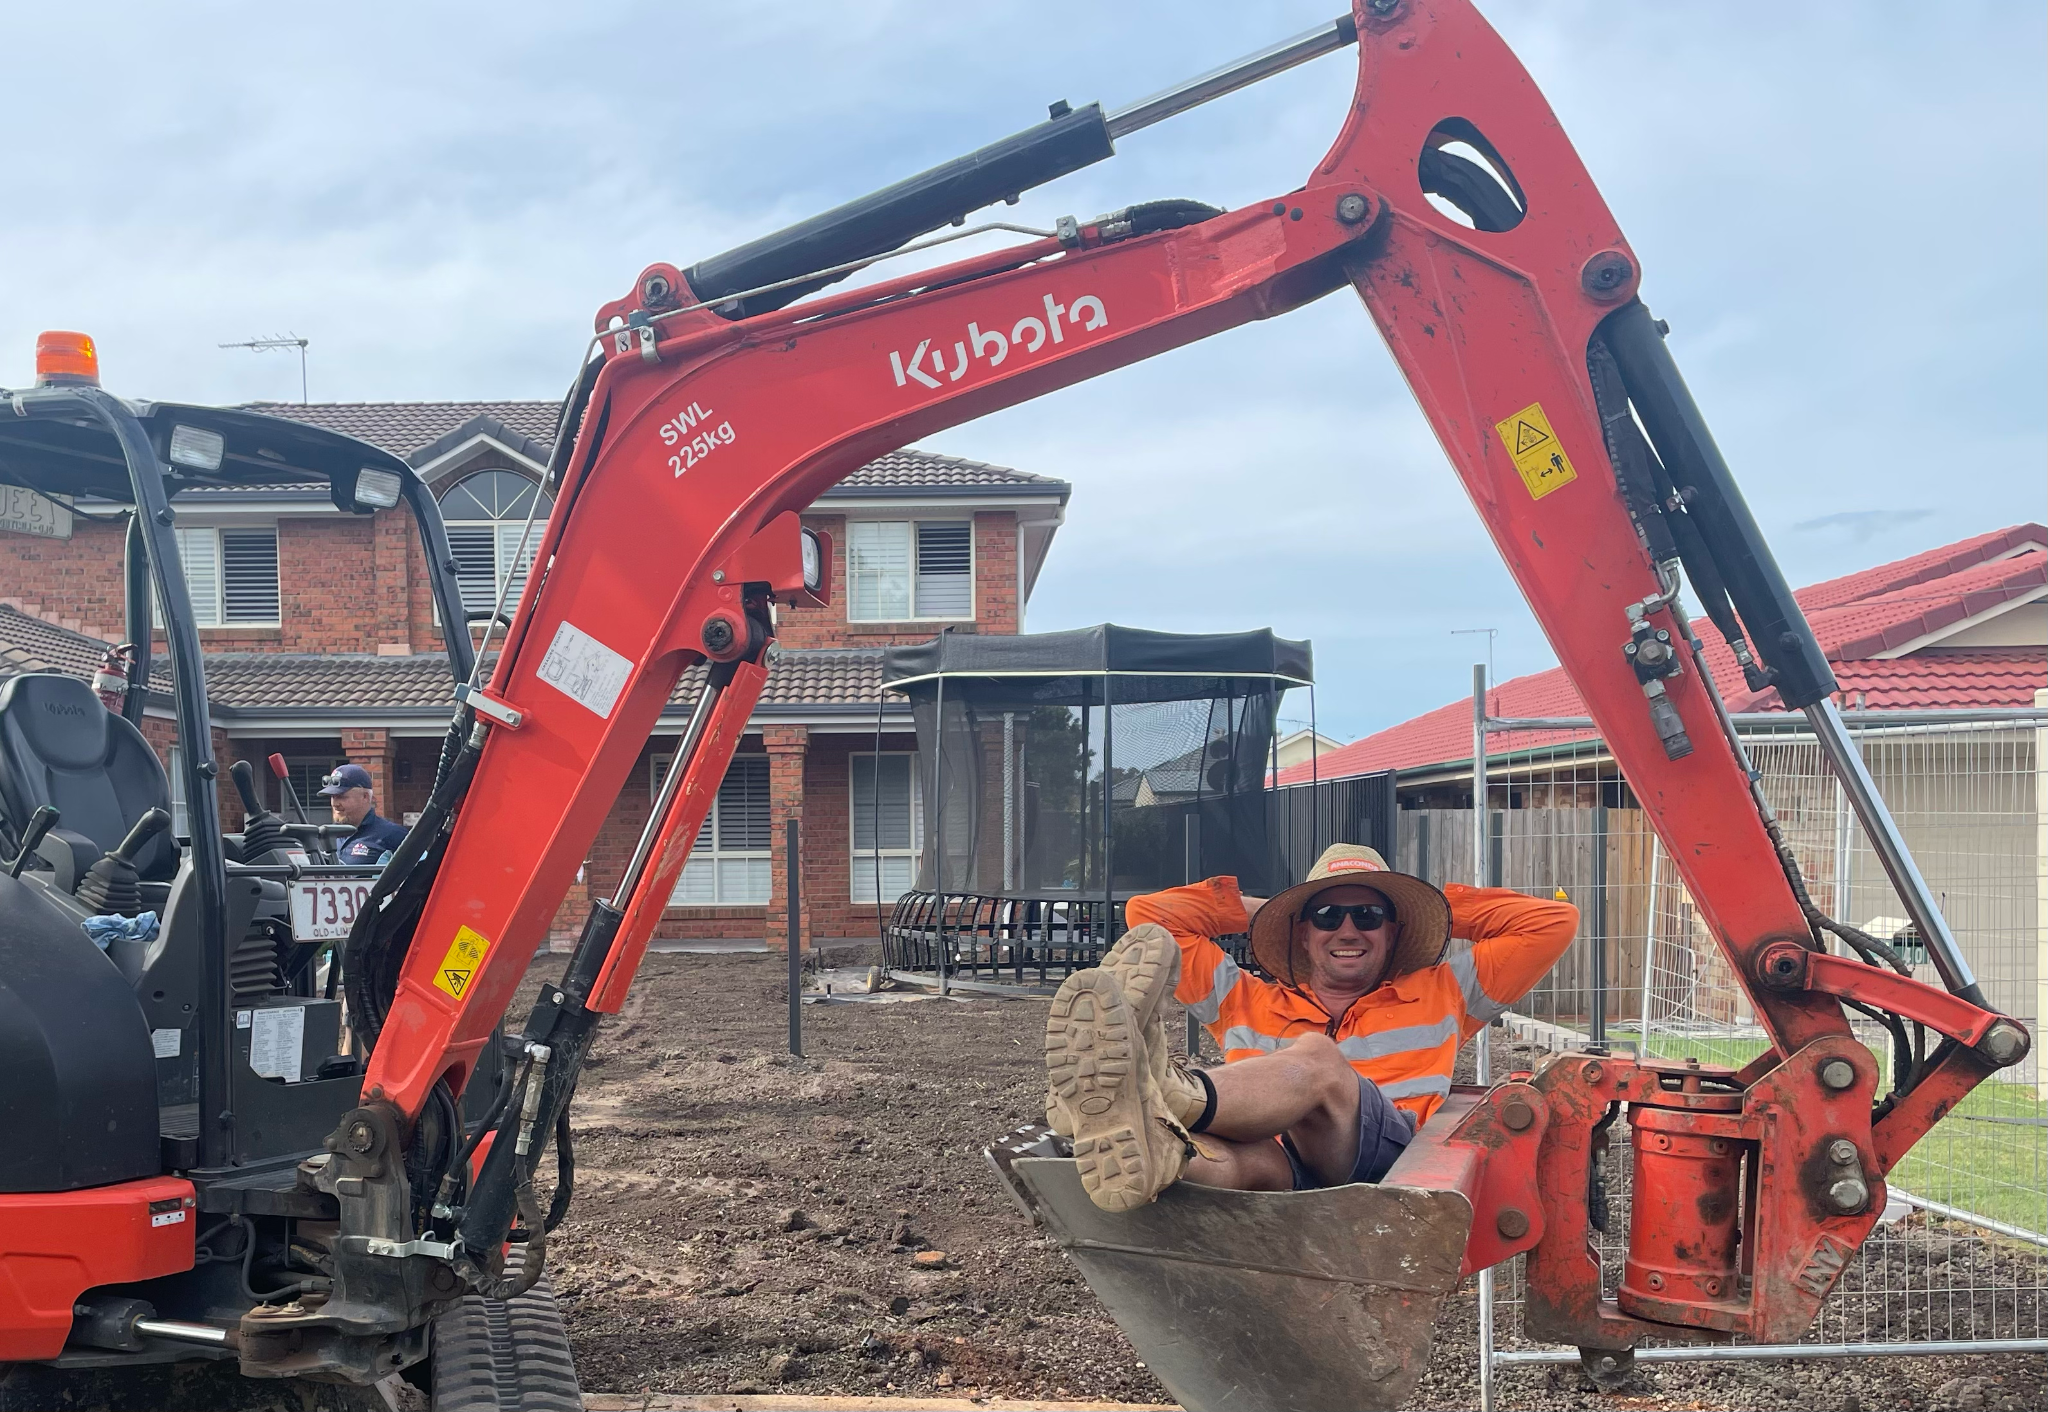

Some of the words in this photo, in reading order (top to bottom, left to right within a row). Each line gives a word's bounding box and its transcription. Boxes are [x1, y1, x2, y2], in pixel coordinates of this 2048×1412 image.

[889, 293, 1109, 389] Kubota
[659, 401, 713, 446] SWL
[668, 420, 736, 478] 225kg
